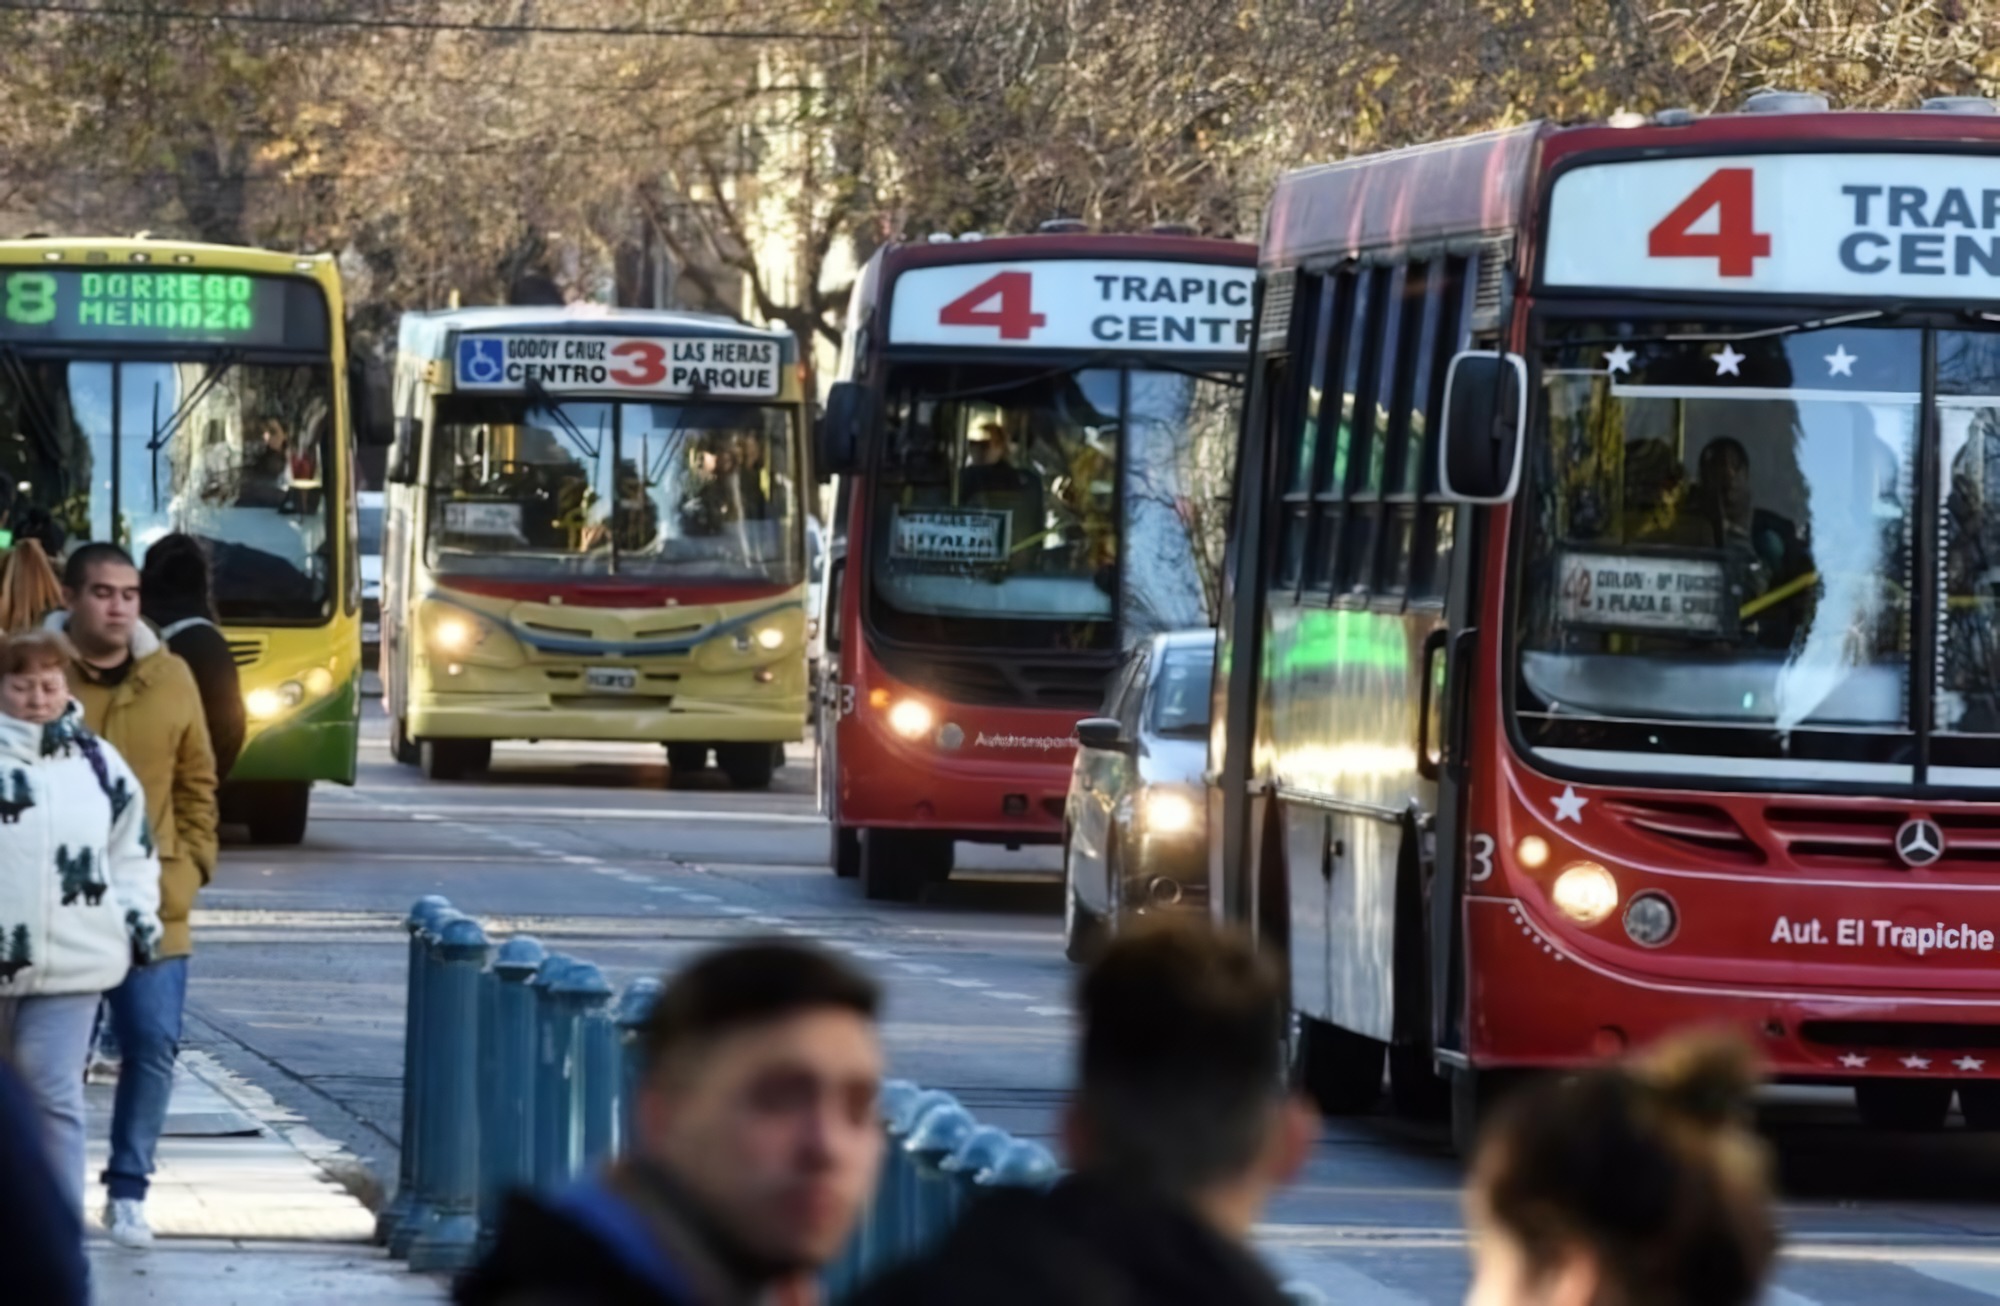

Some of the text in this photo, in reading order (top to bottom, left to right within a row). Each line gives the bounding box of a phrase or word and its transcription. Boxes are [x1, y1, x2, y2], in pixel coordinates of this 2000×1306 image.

[1648, 168, 1771, 277] 4
[1838, 232, 2000, 277] CEN
[5, 272, 57, 323] 8
[80, 273, 252, 300] DORREGO
[1094, 275, 1257, 306] TRAPIC
[79, 301, 252, 329] MENDOZA
[939, 271, 1046, 339] 4
[508, 339, 606, 361] GODOY CRUZ
[609, 341, 668, 386] 3
[673, 343, 771, 364] LAS HERAS
[506, 363, 607, 384] CENTRO
[673, 367, 771, 389] PARQUE
[1471, 833, 1495, 881] 3
[1770, 916, 1995, 956] Aut. El Trapiche
